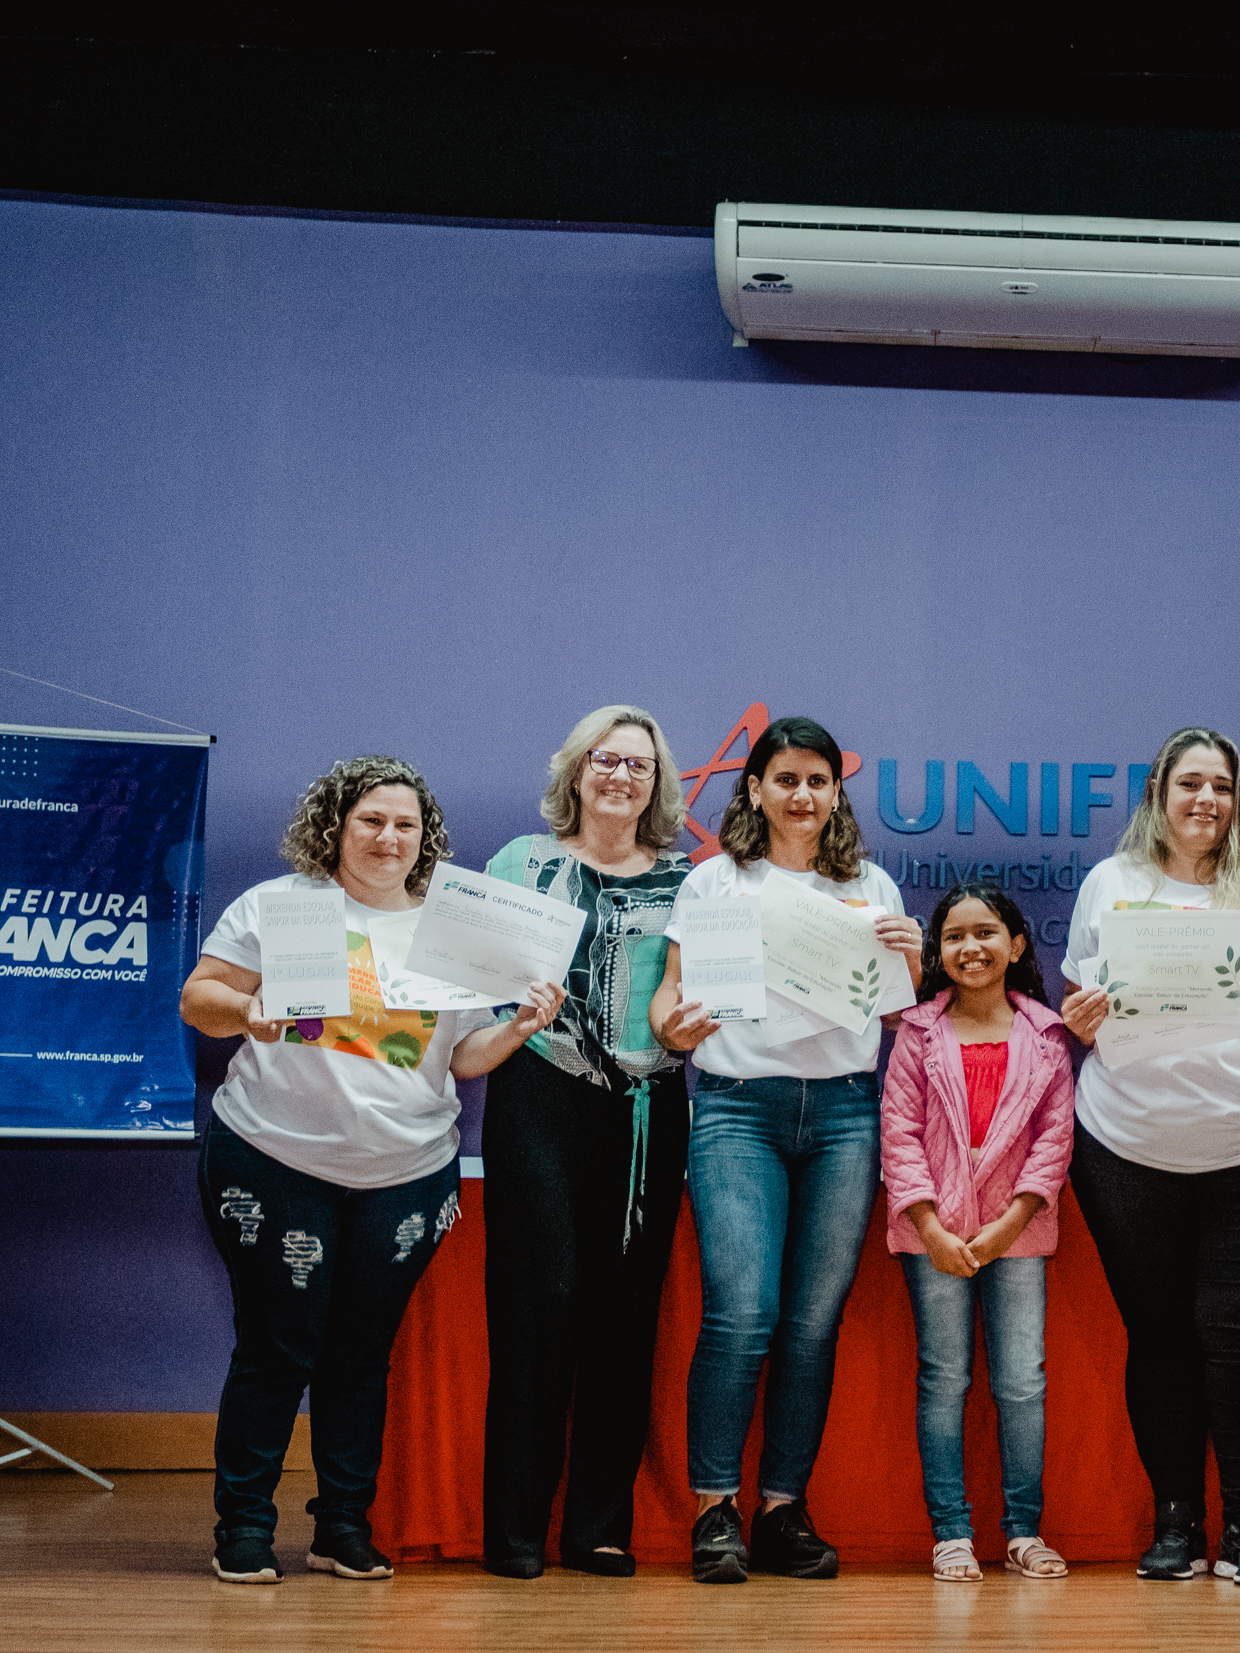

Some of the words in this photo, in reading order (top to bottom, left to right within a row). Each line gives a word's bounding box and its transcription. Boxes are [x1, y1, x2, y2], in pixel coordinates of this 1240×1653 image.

[876, 848, 1098, 892] Universid
[457, 886, 487, 900] FRANCA
[0, 888, 148, 919] FEITURA
[265, 902, 302, 914] MERENDA
[492, 896, 543, 917] CERTIFICADO
[265, 915, 290, 927] SABOR
[291, 915, 302, 925] DA
[685, 909, 720, 921] MERENDA
[796, 899, 869, 942] VALE-PRÊMIO
[684, 922, 708, 933] SABOR
[709, 922, 720, 932] DA
[1135, 925, 1215, 937] VALE-PRÊMIO
[0, 916, 148, 966] ANCA
[790, 937, 822, 960] Smart
[825, 954, 840, 967] TV
[82, 968, 113, 981] COM
[114, 968, 148, 982] VOCÊ
[287, 966, 336, 979] LUGAR
[1148, 964, 1183, 975] Smart
[1185, 964, 1200, 975] TV
[706, 970, 753, 983] LUGAR
[353, 1001, 375, 1011] quipe
[36, 1050, 144, 1064] www.franca.sp.gov.br
